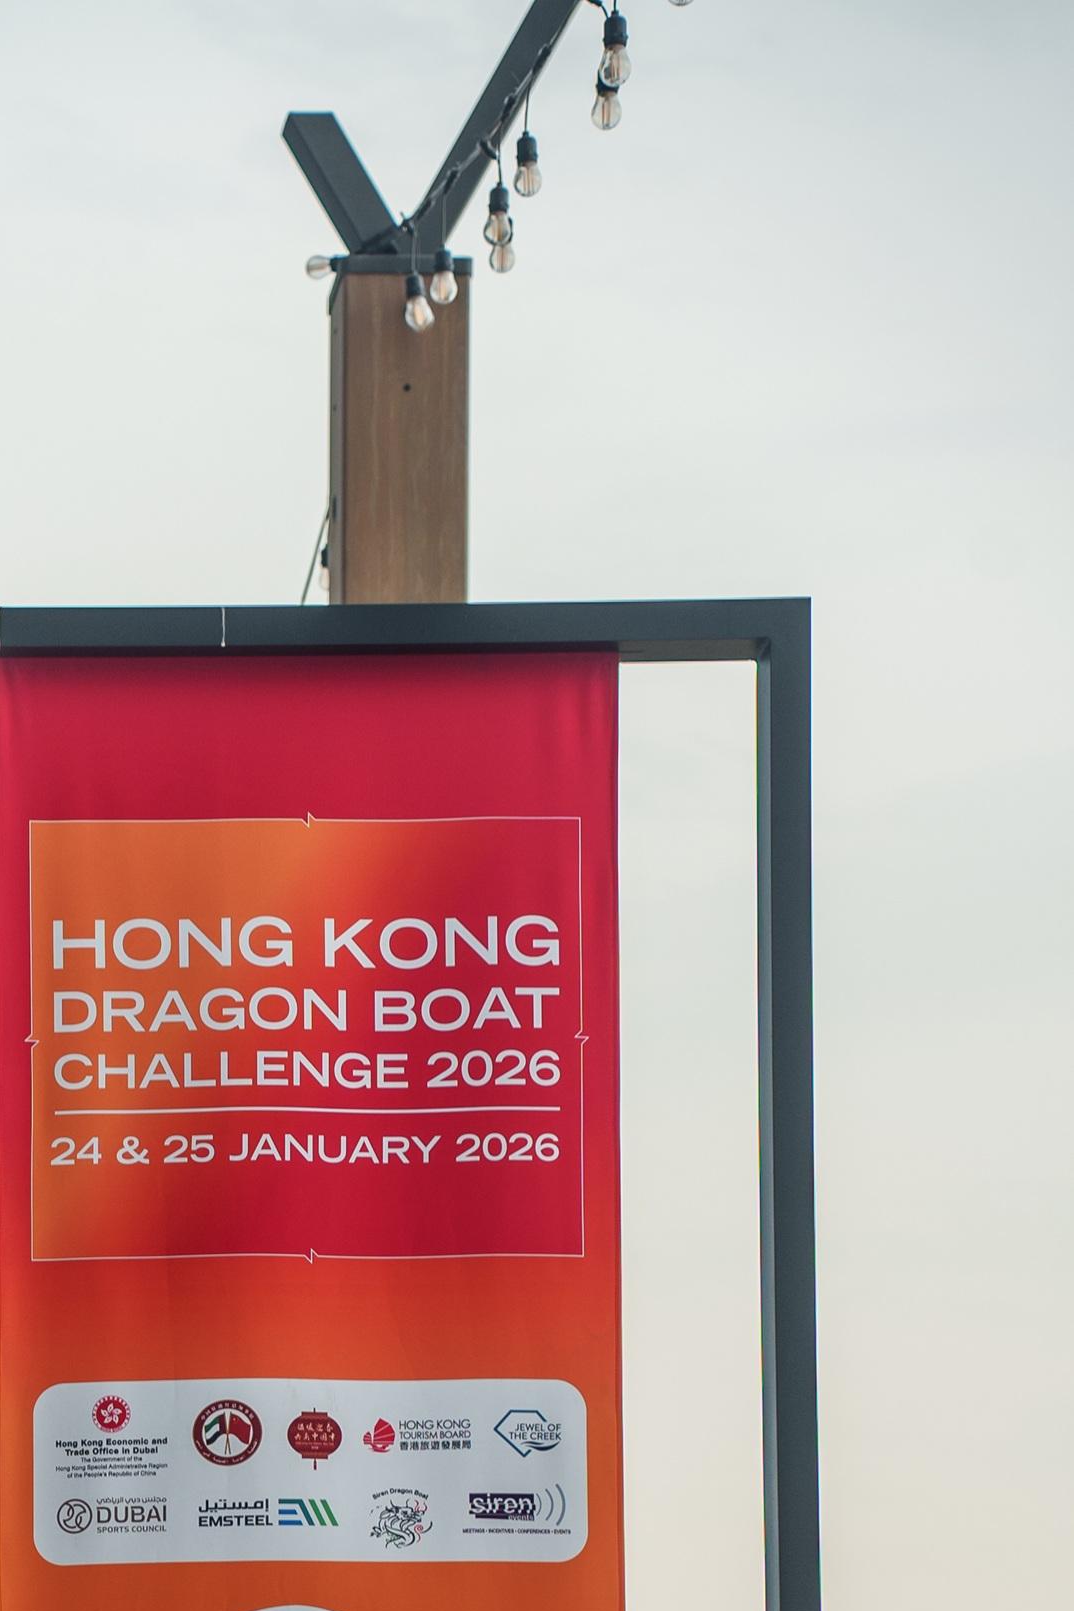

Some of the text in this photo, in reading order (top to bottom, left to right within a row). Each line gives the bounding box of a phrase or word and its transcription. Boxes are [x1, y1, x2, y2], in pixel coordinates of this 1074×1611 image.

[52, 915, 560, 970] HONG KONG
[53, 987, 560, 1034] DRAGON BOAT
[53, 1049, 560, 1090] CHALLENGE 2026
[50, 1133, 560, 1166] 24 & 25 JANUARY 2026
[398, 1418, 471, 1430] HONG KONG
[515, 1423, 562, 1432] JEWEL OF
[399, 1430, 471, 1440] TOURISM BOARD
[509, 1432, 562, 1441] THE CREEK
[55, 1437, 168, 1449] Hong Kong Economic and
[65, 1448, 90, 1456] Trade
[93, 1447, 119, 1455] Office
[133, 1446, 159, 1454] Dubai
[55, 1465, 71, 1473] Hong
[87, 1464, 107, 1472] Special
[149, 1462, 168, 1470] Region
[372, 1489, 389, 1500] Siren
[389, 1487, 414, 1495] Dragon
[198, 1498, 269, 1513] إمستيل
[471, 1493, 533, 1514] siren
[96, 1505, 167, 1524] DUBAI
[198, 1515, 273, 1528] EMSTEEL
[97, 1525, 167, 1534] SPORTS COUNCIL
